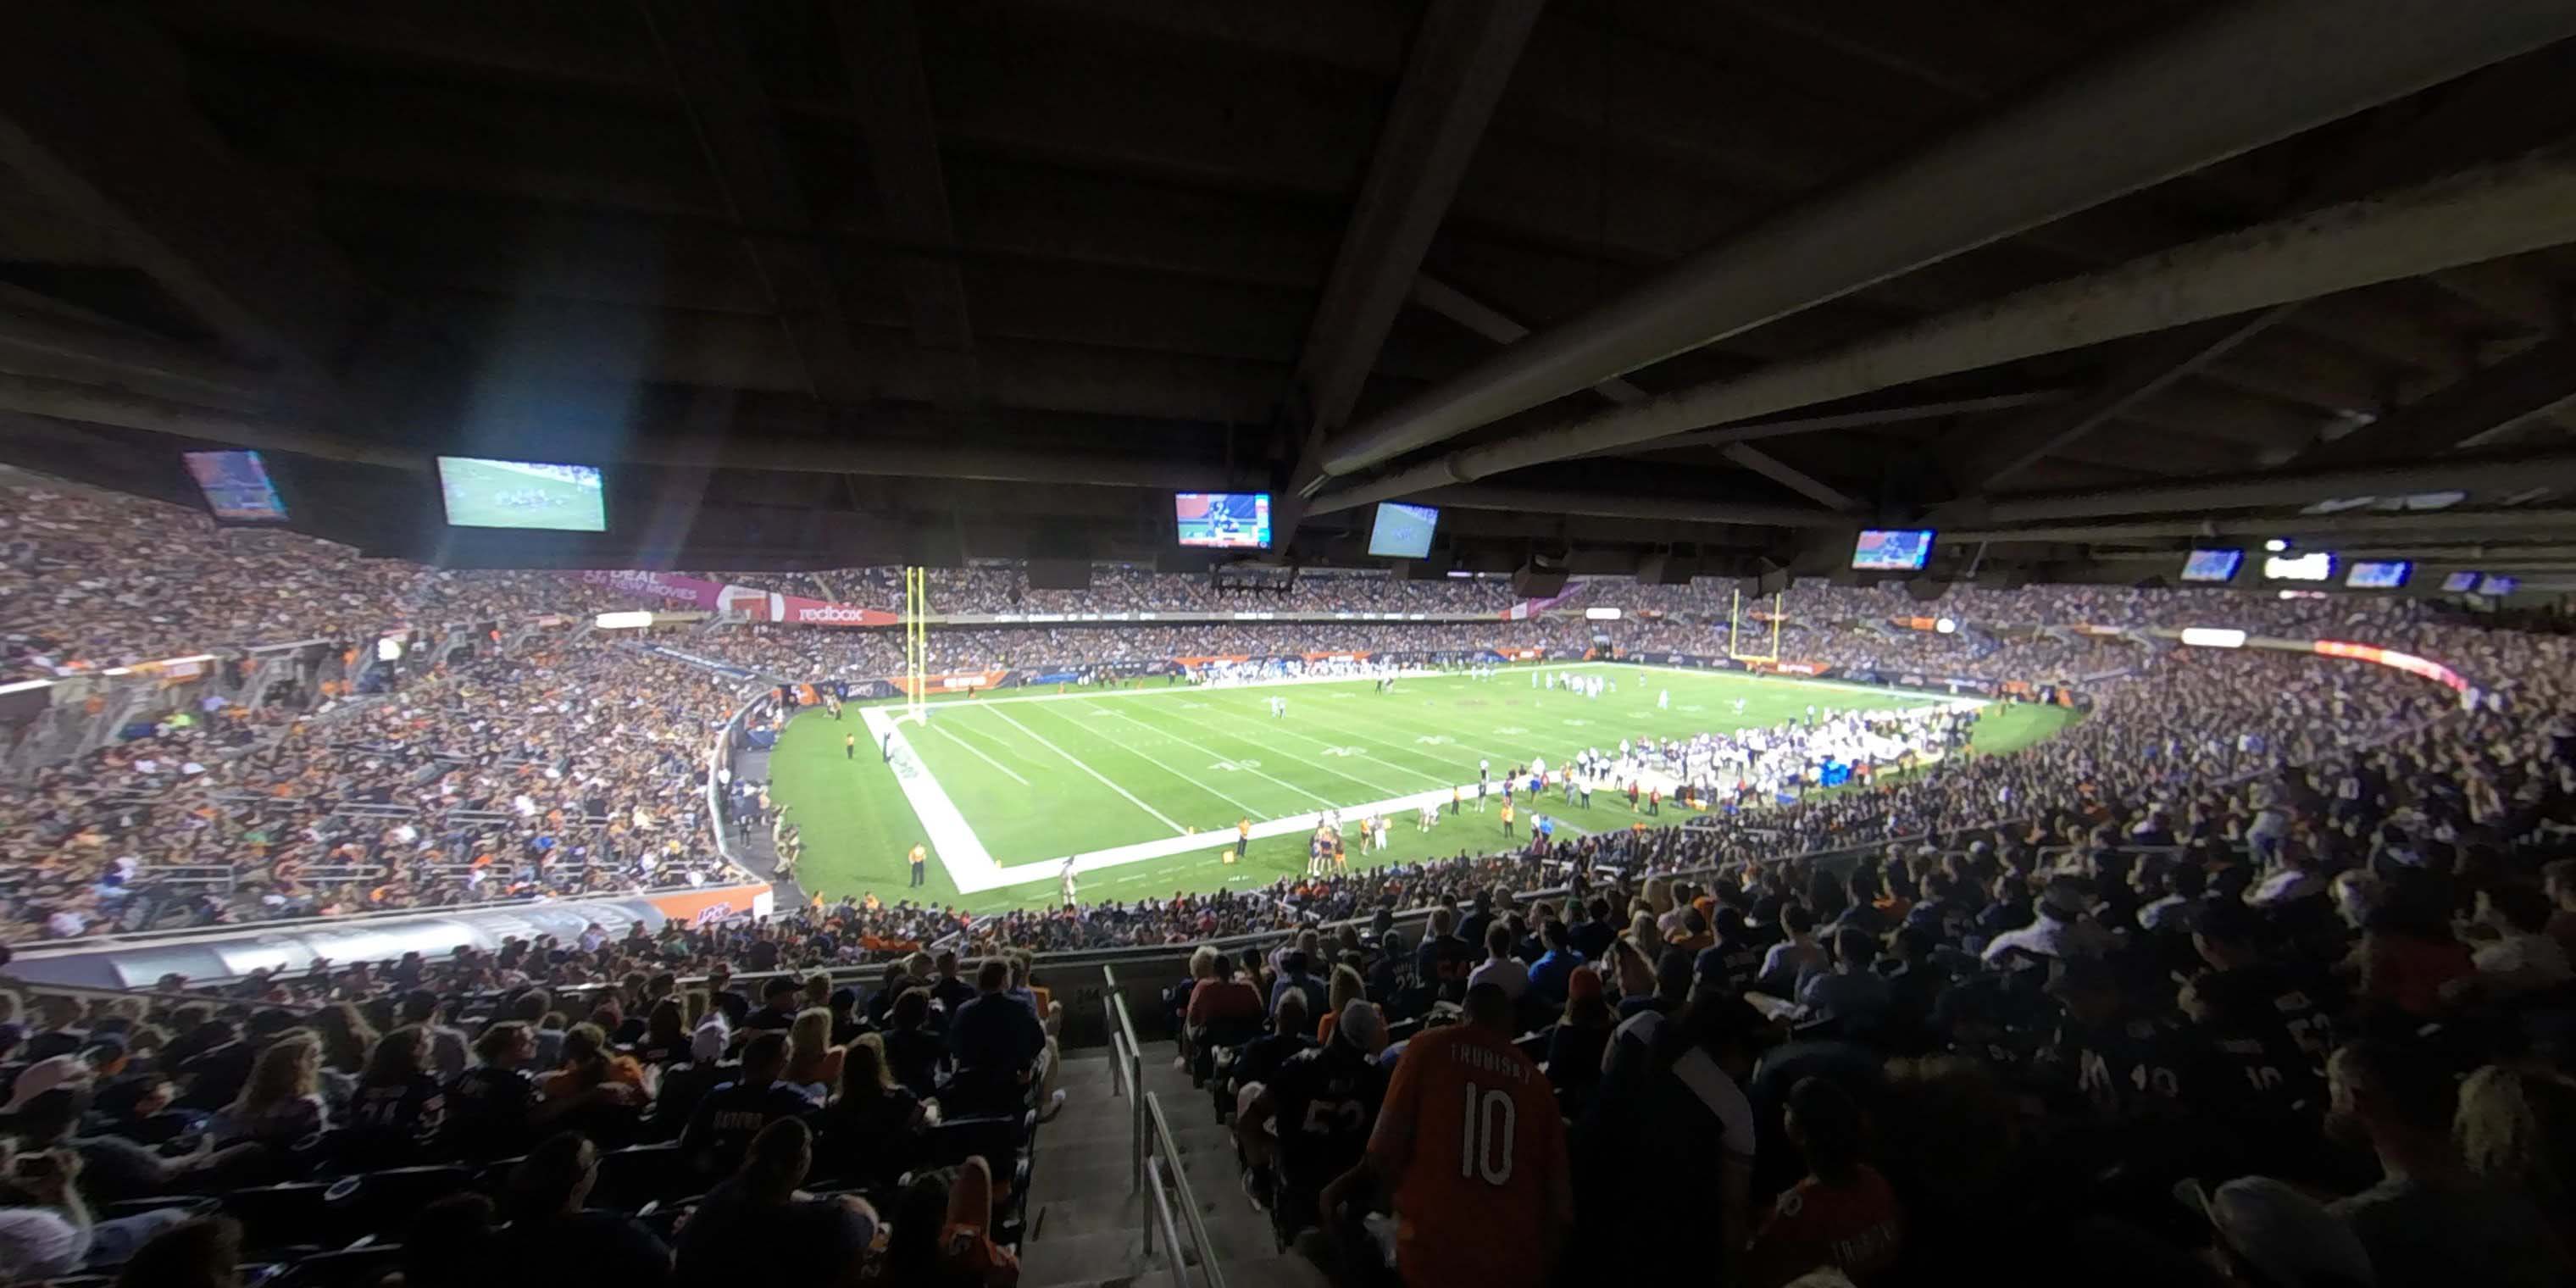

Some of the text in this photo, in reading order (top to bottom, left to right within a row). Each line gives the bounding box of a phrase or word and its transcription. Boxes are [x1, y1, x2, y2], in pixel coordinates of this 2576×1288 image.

[646, 584, 697, 600] MOVIES
[799, 606, 863, 621] redbox
[1463, 1080, 1515, 1185] 10
